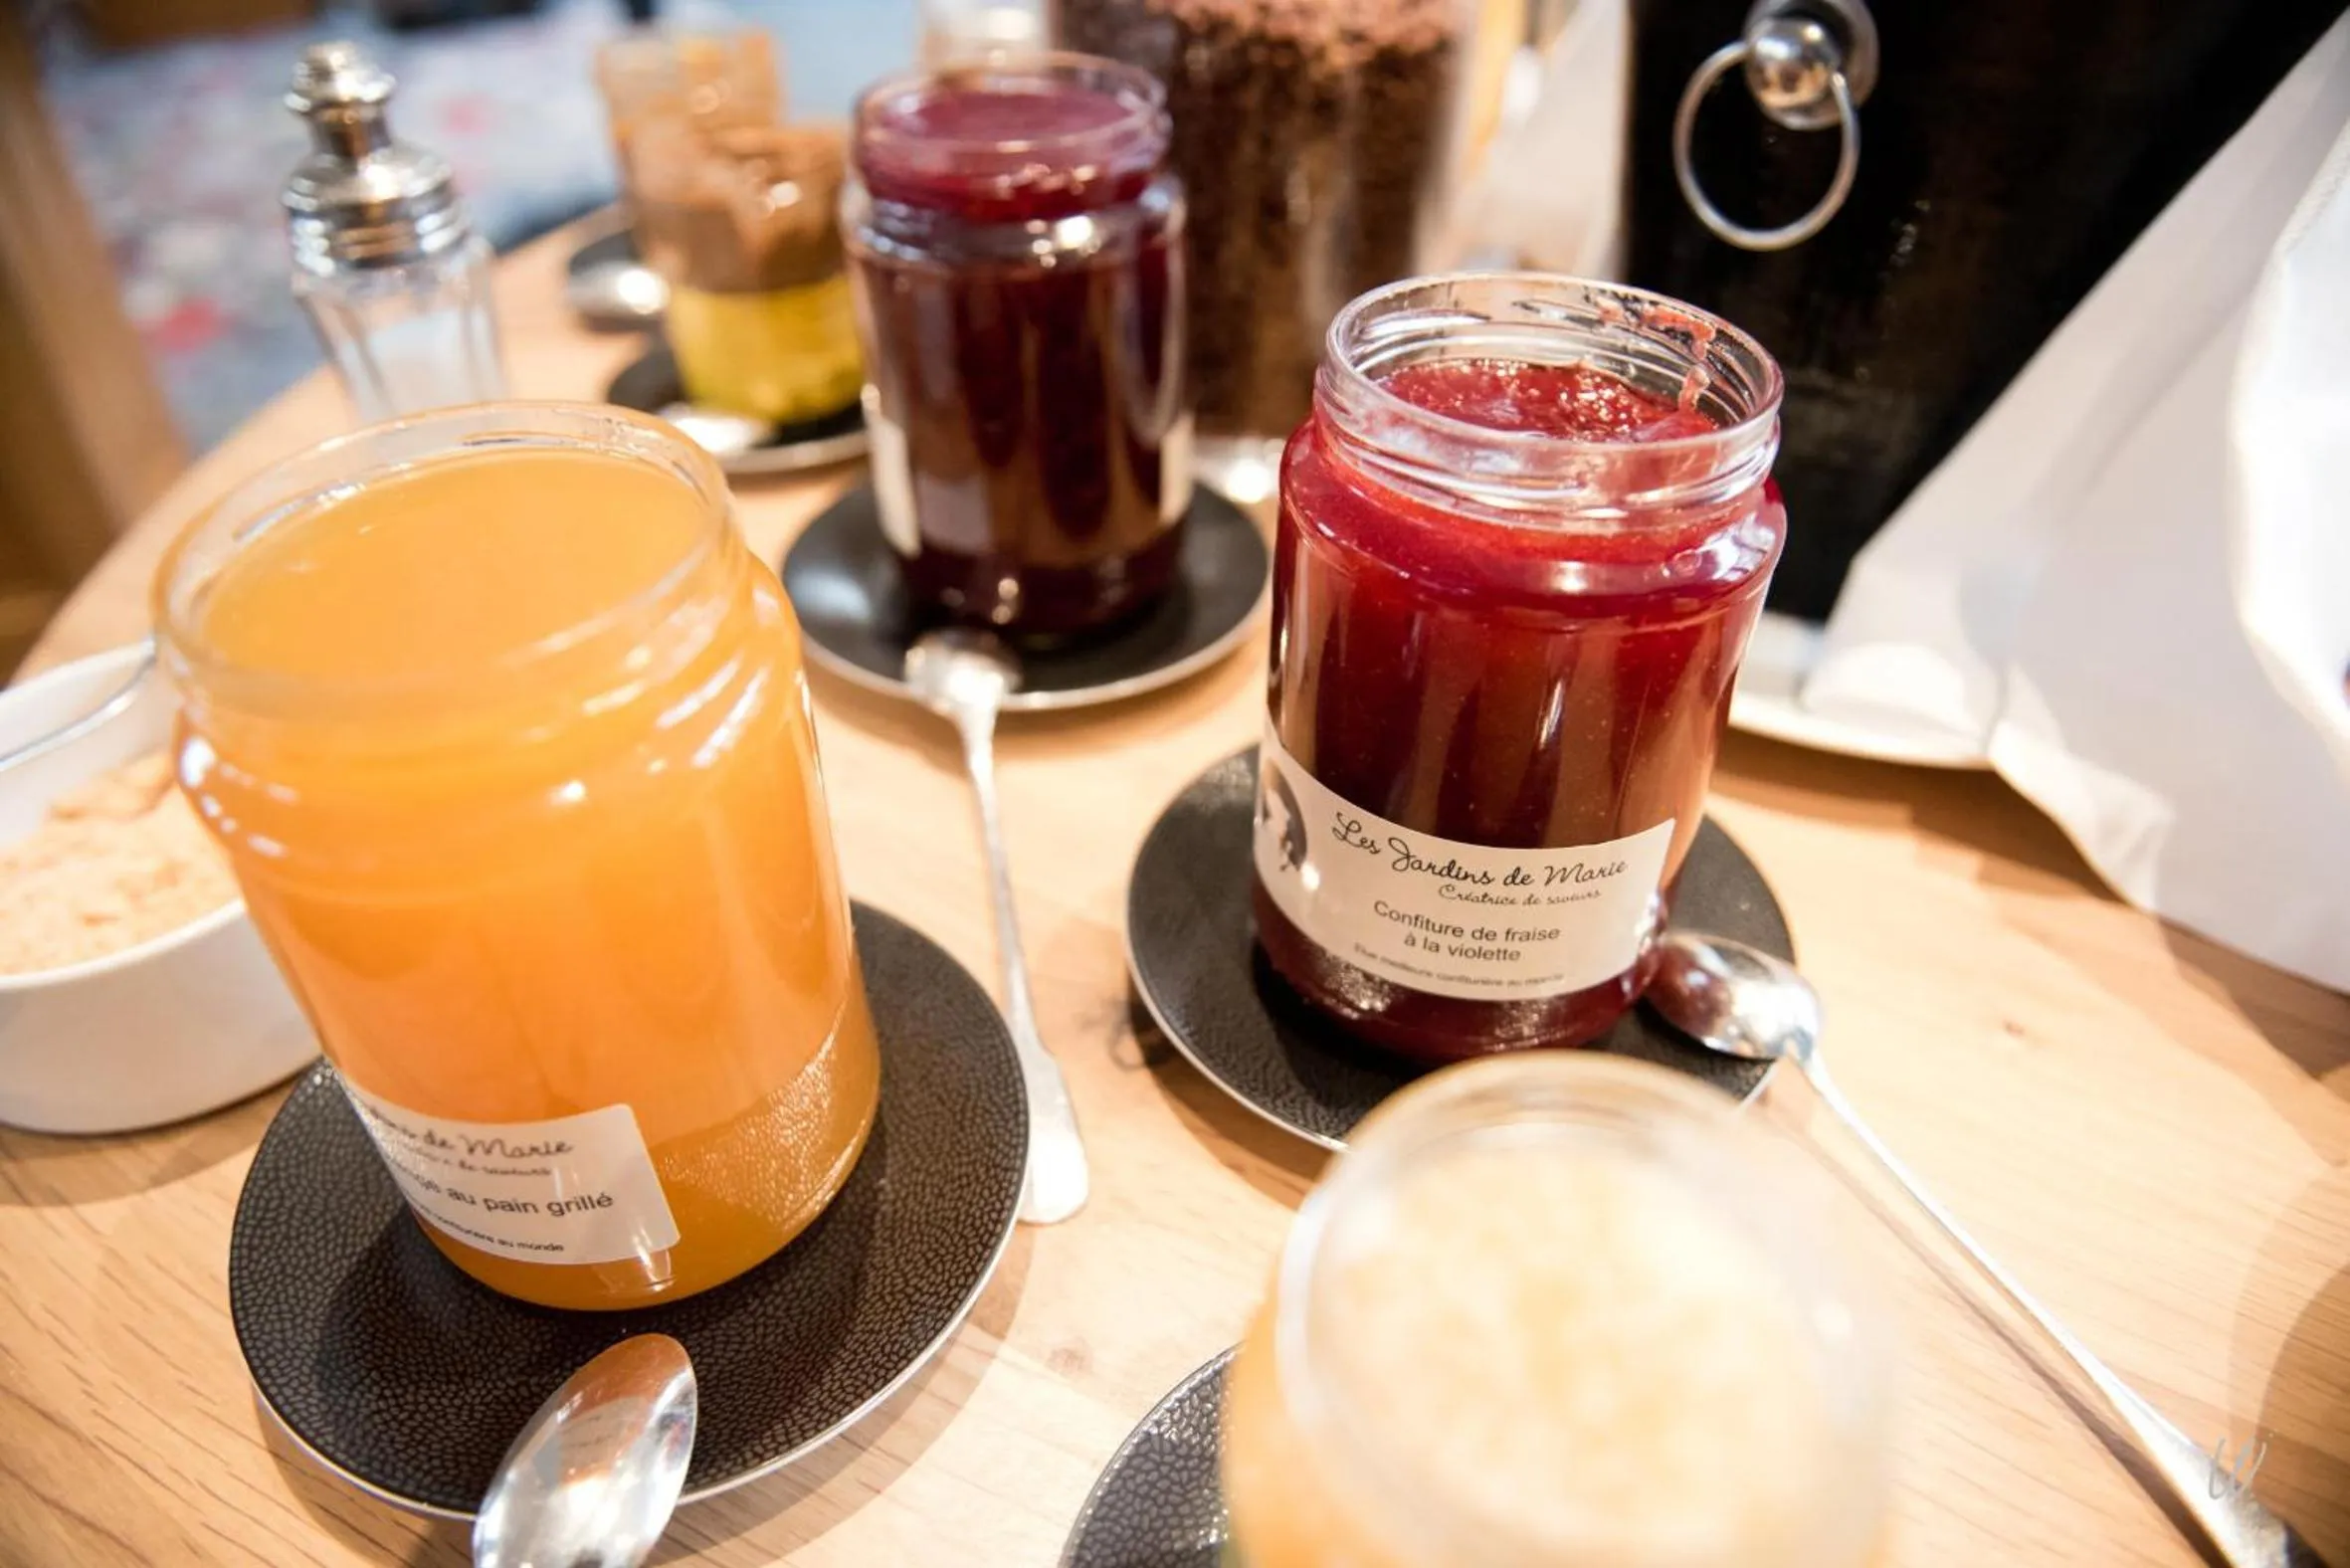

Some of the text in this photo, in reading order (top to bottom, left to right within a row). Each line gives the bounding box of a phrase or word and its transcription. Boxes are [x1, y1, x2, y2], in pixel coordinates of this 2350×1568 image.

[1332, 812, 1629, 887] Les Jardins de Marie
[1374, 899, 1562, 943] Confiture de fraise
[1404, 931, 1521, 962] à la violette
[458, 1132, 574, 1159] Marie
[446, 1188, 615, 1217] au pain grillé
